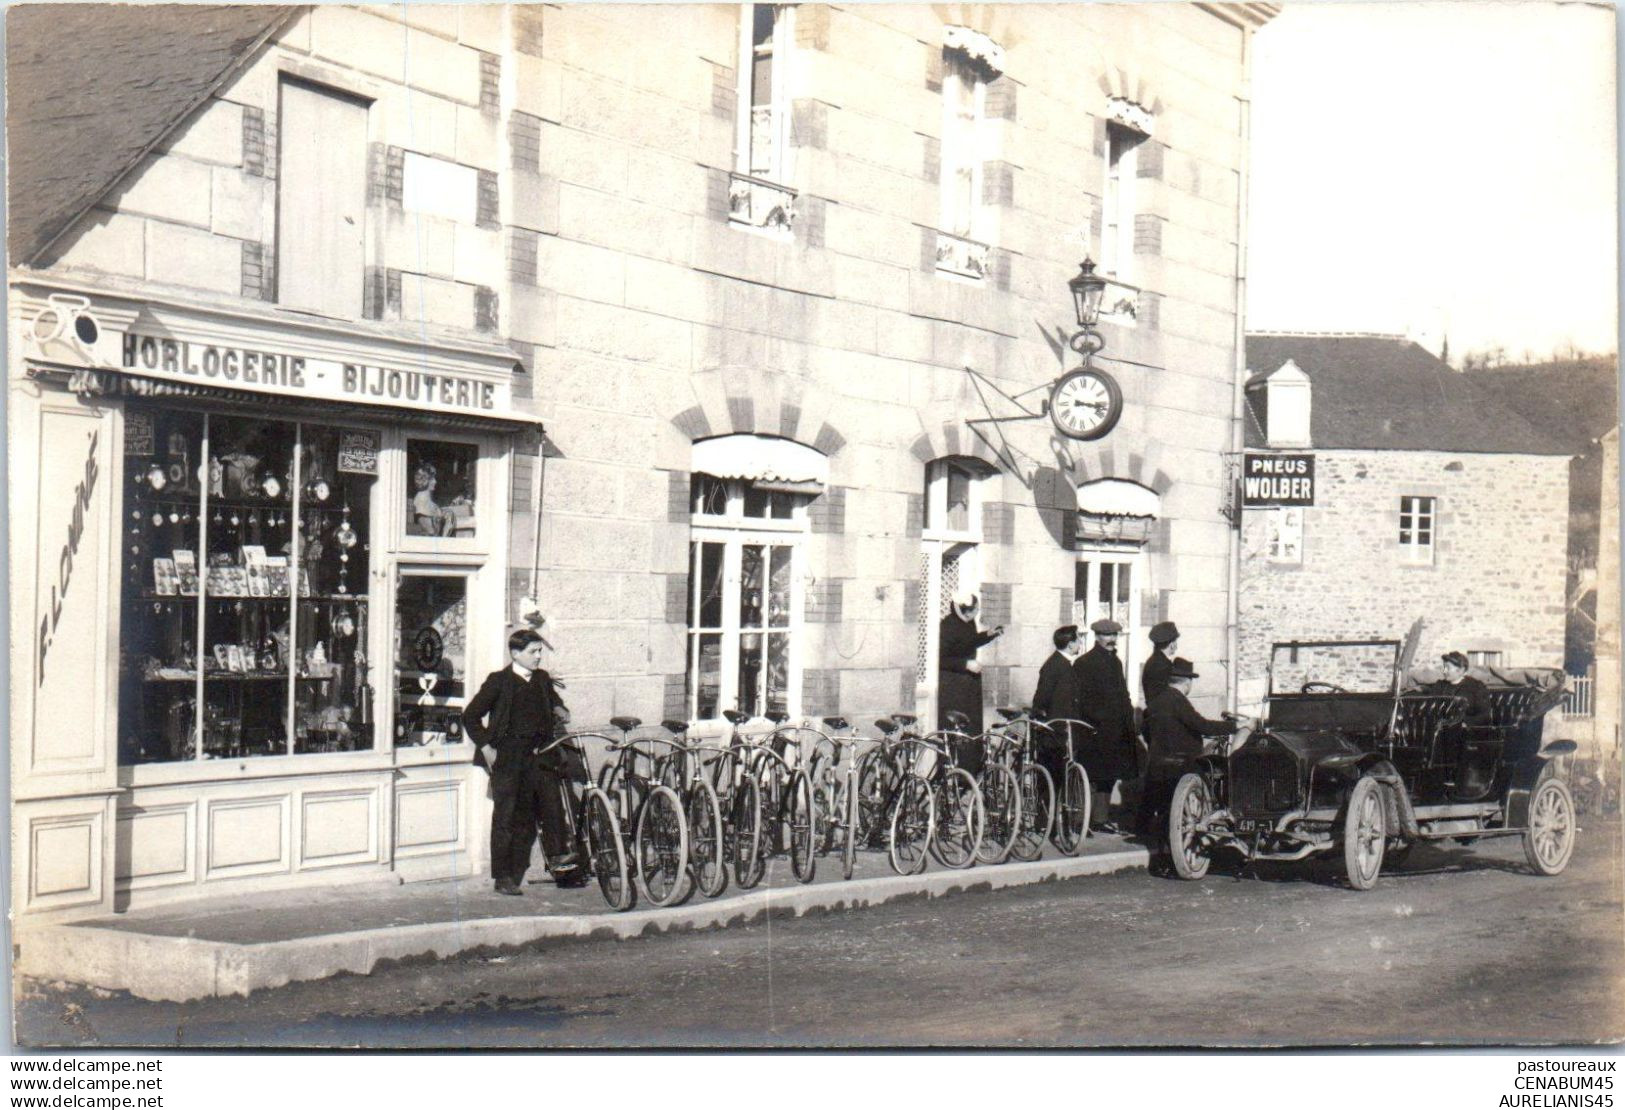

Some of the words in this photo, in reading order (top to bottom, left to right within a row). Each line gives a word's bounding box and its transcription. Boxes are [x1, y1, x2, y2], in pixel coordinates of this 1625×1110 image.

[122, 333, 306, 388] HORLOGERIE
[342, 364, 495, 410] BIJOUTERIE
[1251, 459, 1308, 474] PNEUS
[1245, 477, 1312, 499] WOLBER
